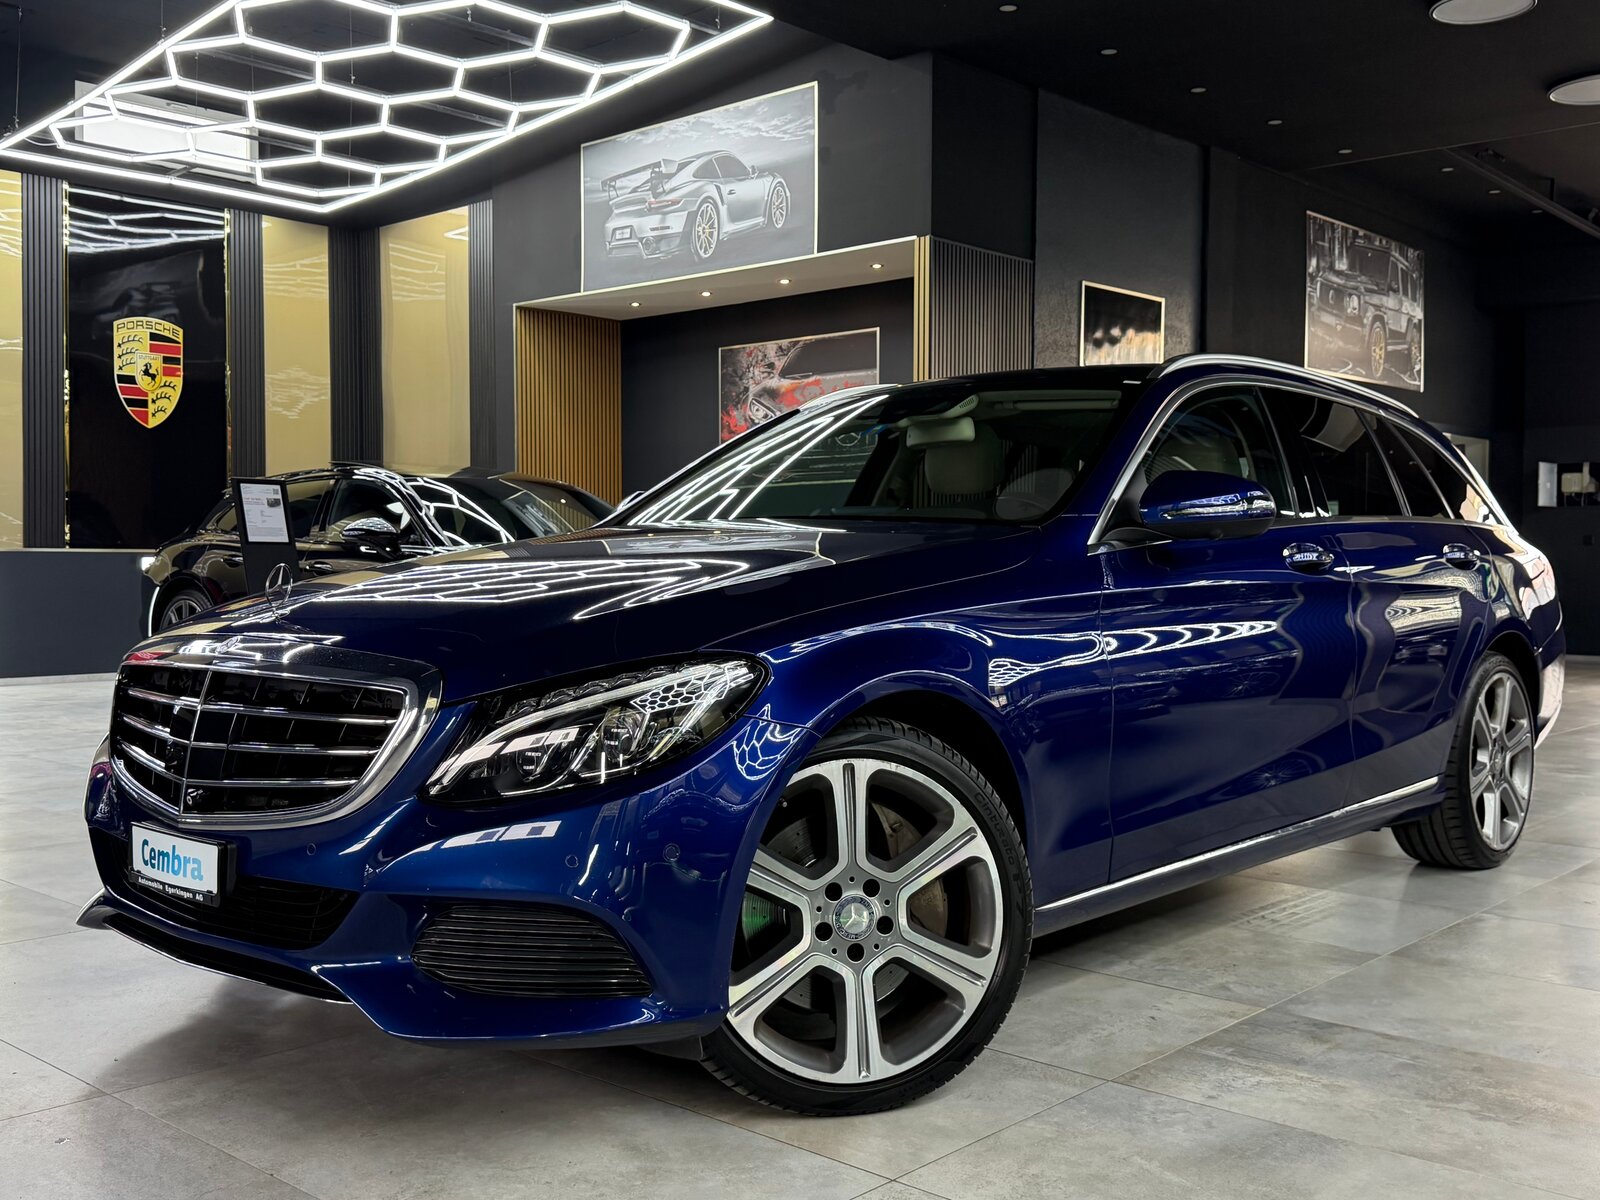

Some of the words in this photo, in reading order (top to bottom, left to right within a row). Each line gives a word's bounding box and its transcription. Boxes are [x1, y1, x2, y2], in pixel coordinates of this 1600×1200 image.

[116, 320, 180, 339] PORSCHE
[141, 838, 204, 881] Cembra
[138, 876, 163, 890] Automobile
[165, 884, 193, 899] Egerkingen
[195, 893, 204, 902] AG
